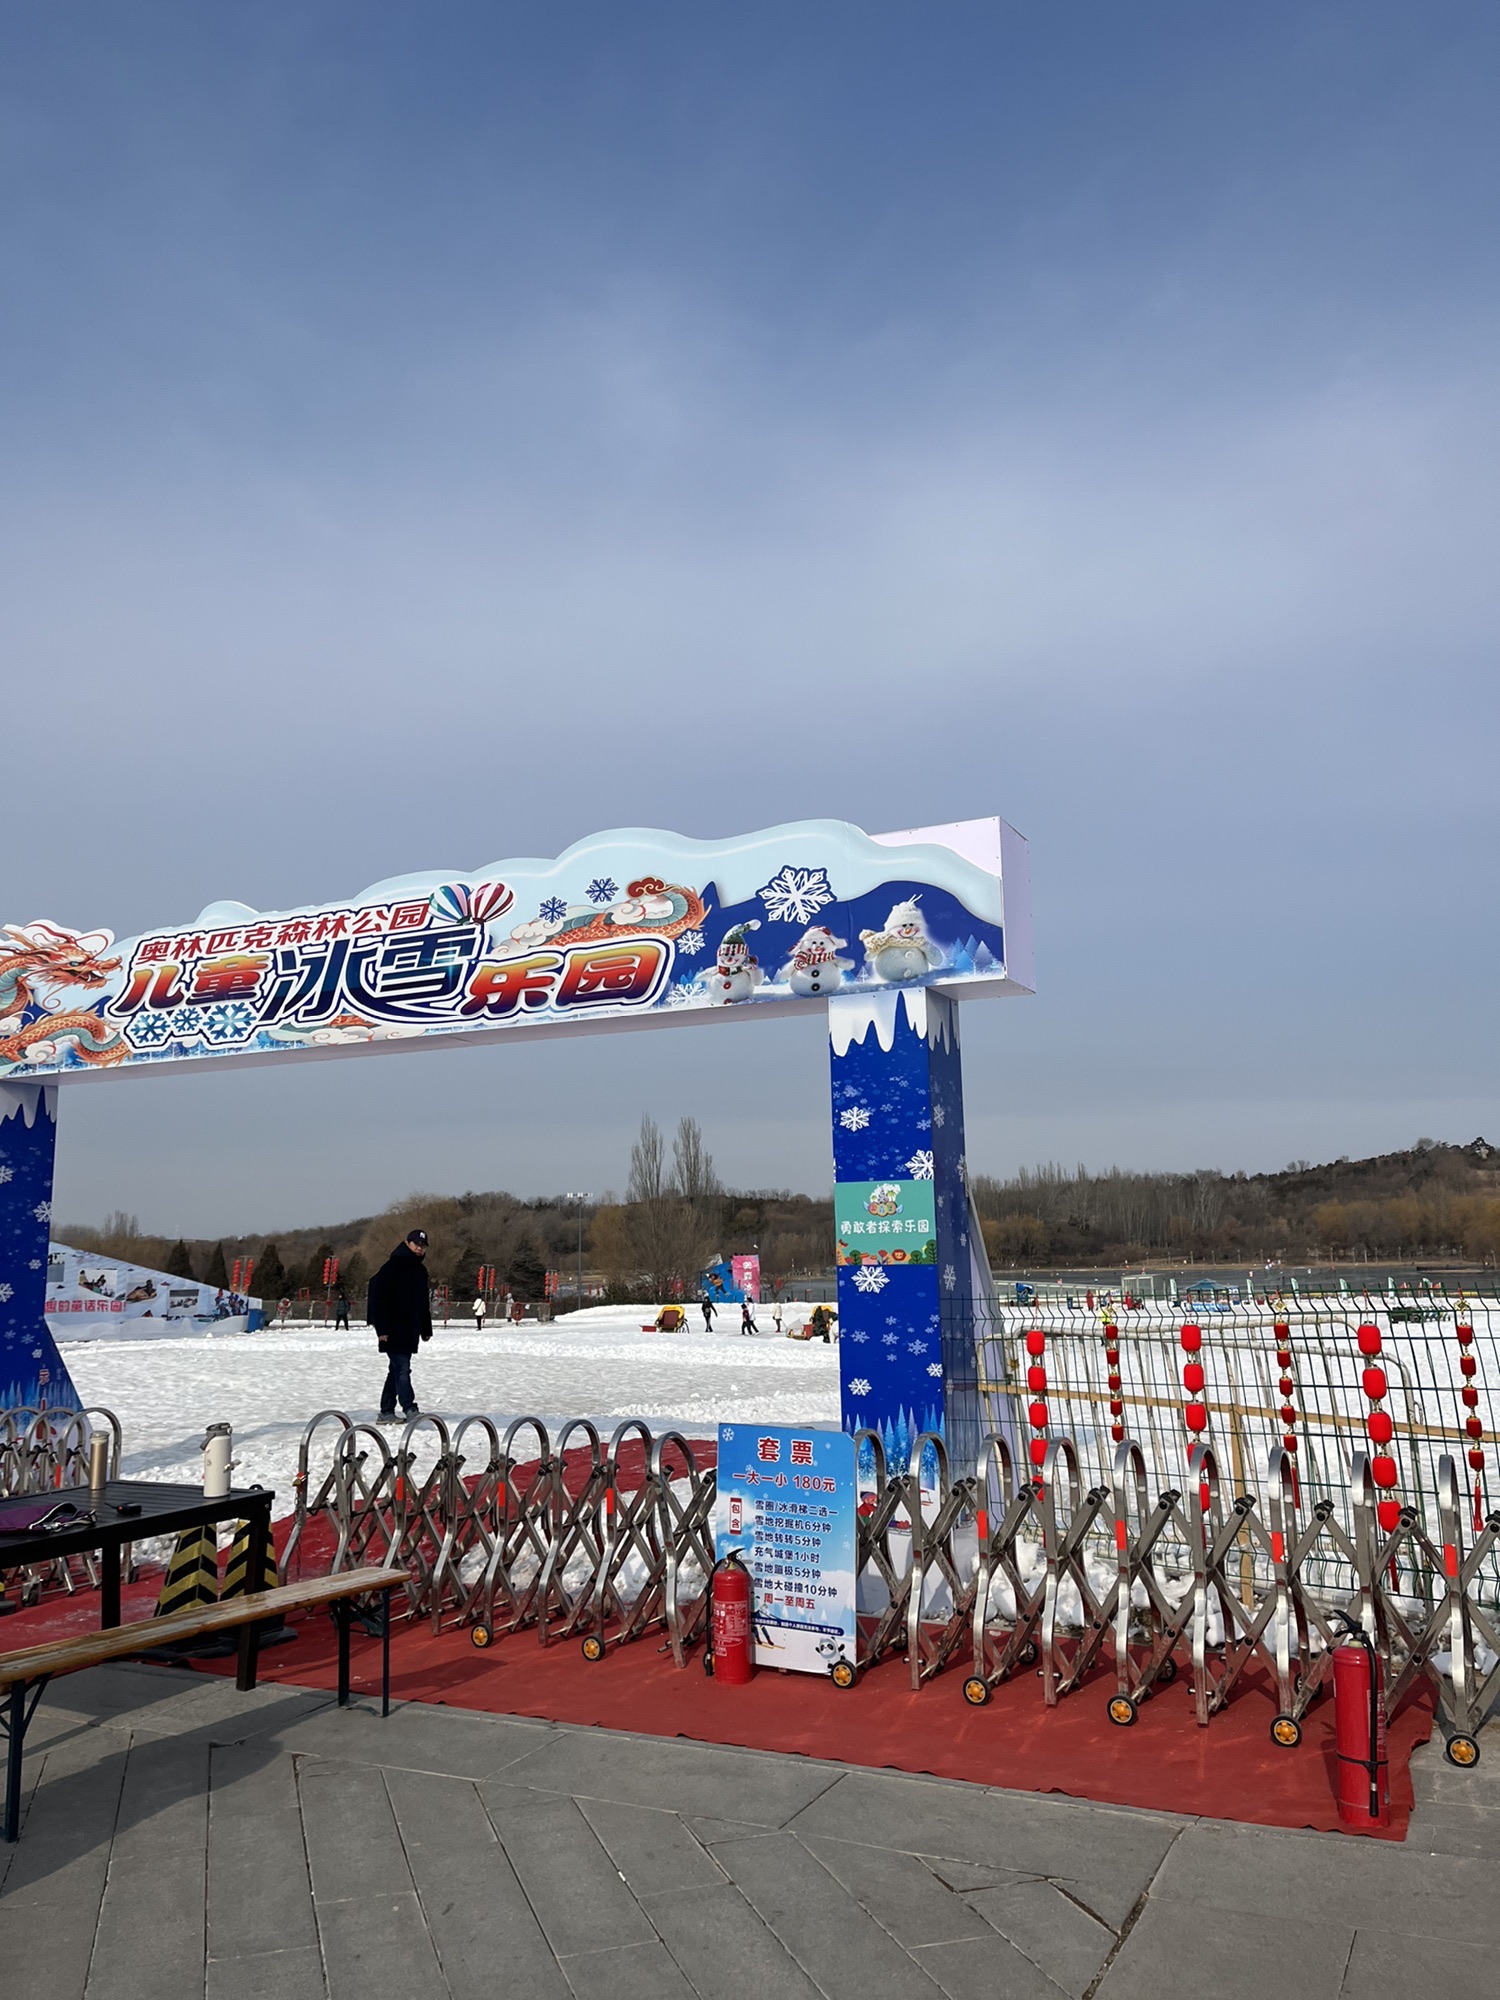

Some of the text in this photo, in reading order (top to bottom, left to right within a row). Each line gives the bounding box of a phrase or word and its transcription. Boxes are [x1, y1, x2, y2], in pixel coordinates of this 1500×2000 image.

[138, 901, 429, 964] 奥林匹克森林公园
[117, 927, 661, 1021] 儿童冰雪乐园
[840, 1219, 929, 1235] 勇敢者探索乐园
[758, 1437, 813, 1465] 套票
[733, 1470, 836, 1492] 一大一小 180元
[731, 1503, 741, 1529] 包含
[755, 1515, 832, 1533] 雪地挖掘机6分钟
[755, 1531, 821, 1547] 雪地转转5分钟
[755, 1546, 820, 1563] 充气城堡1小时
[754, 1577, 838, 1597] 雪地大碰撞10分钟
[764, 1593, 815, 1609] 周一至周五
